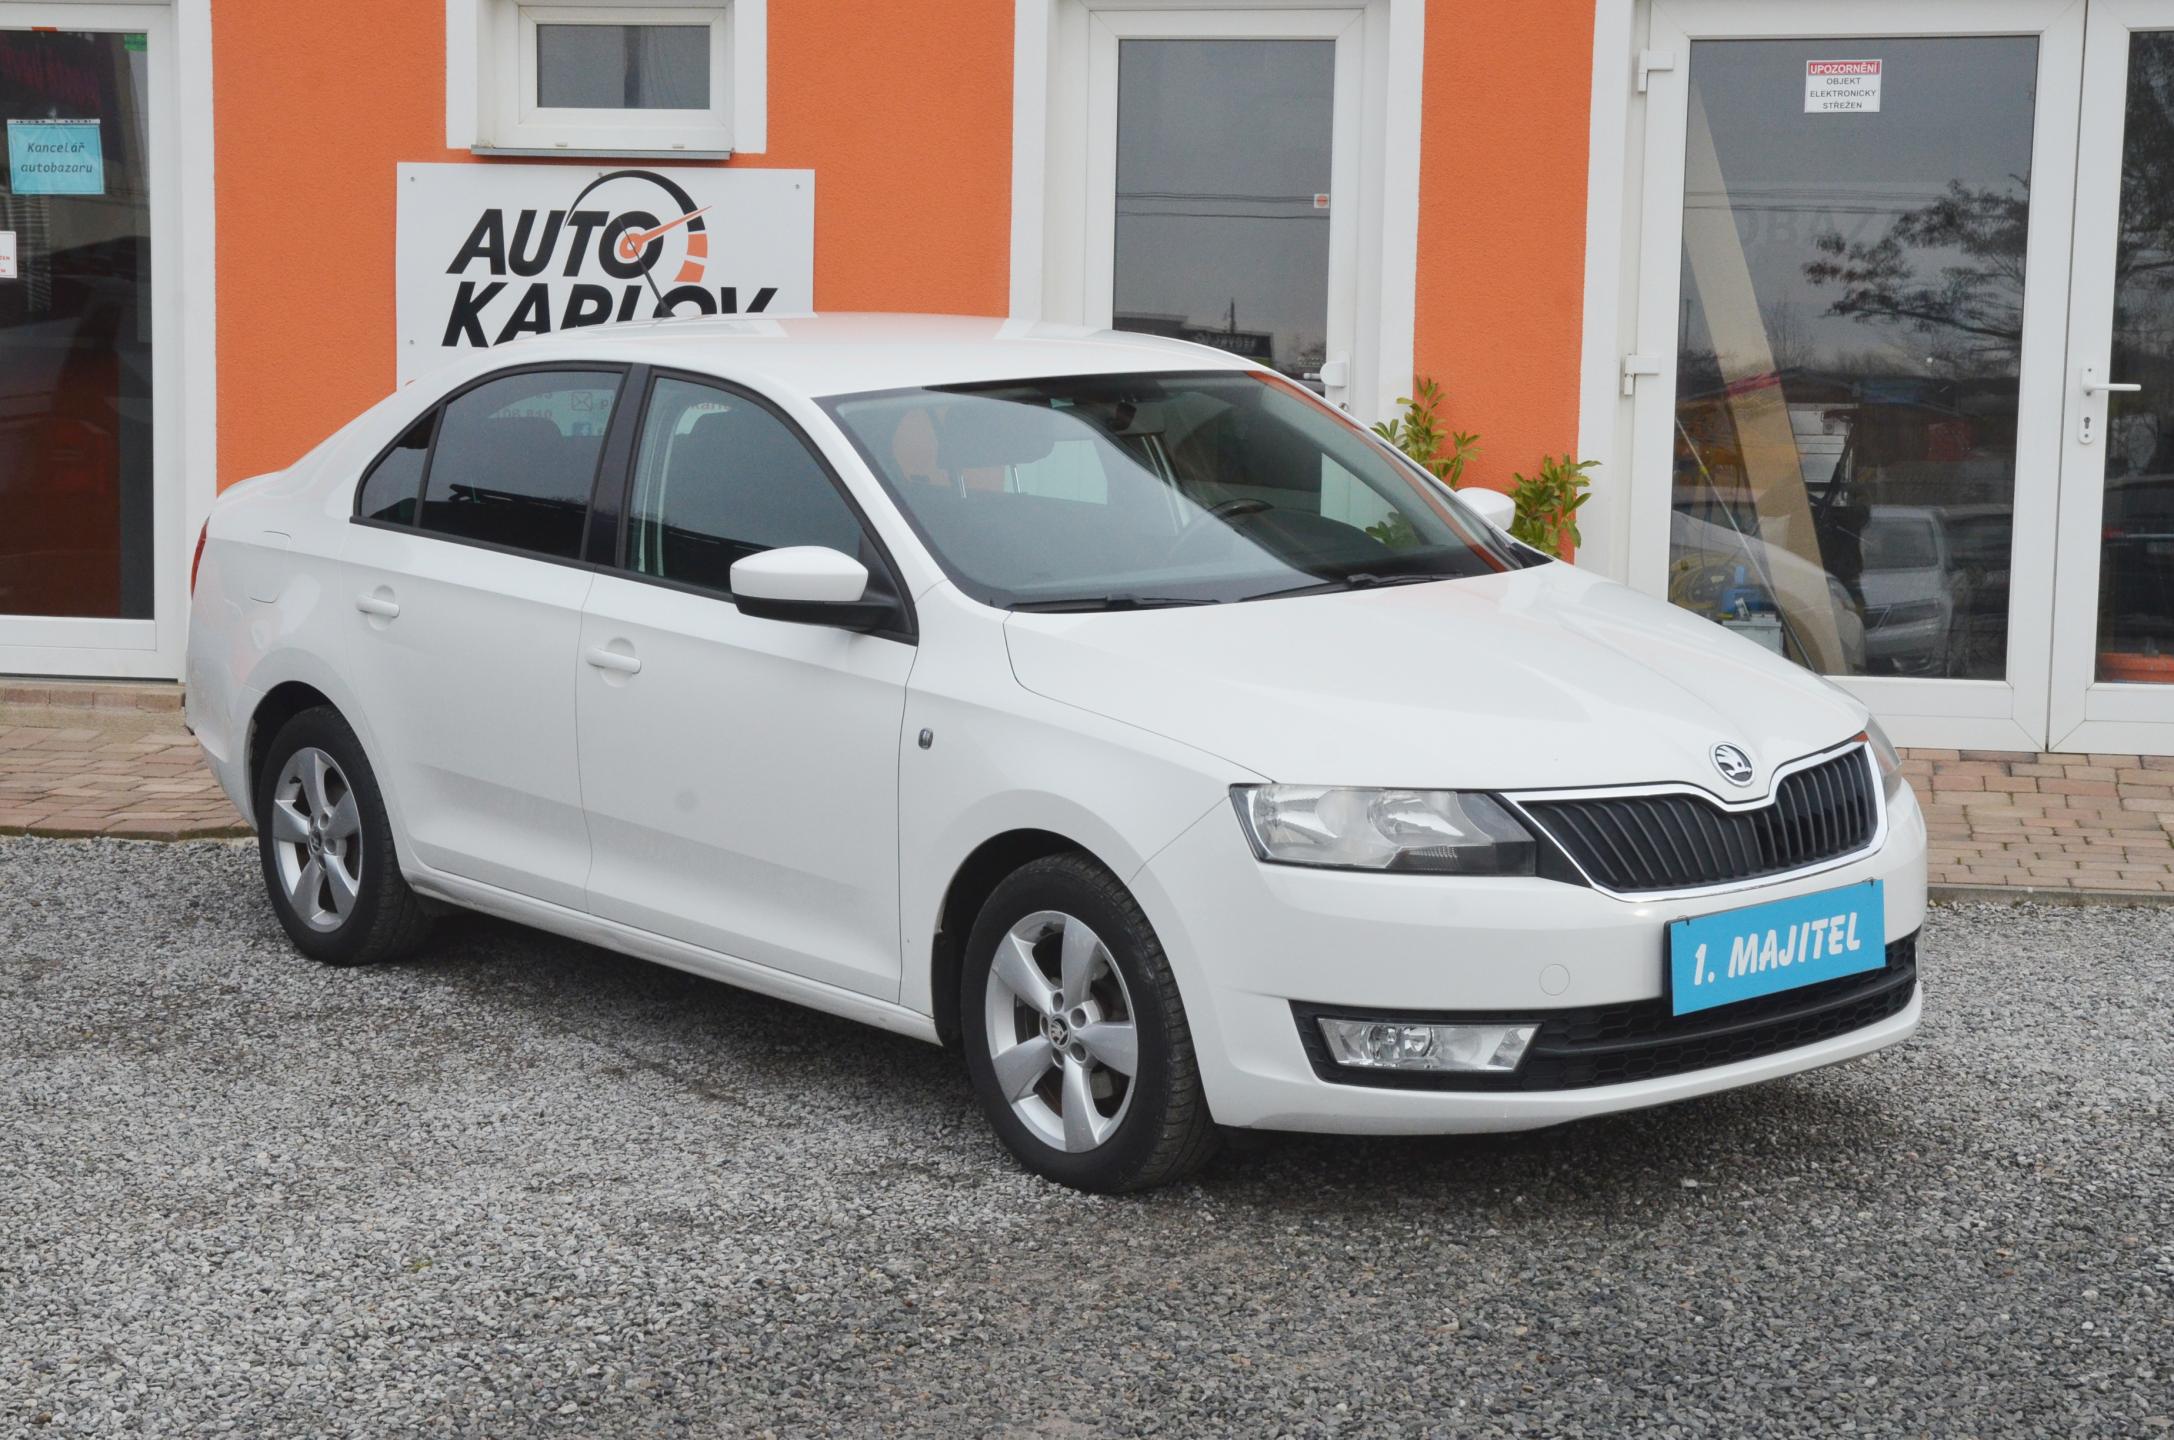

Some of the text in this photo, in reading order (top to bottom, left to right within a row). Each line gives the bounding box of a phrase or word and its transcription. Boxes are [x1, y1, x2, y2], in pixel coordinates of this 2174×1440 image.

[1810, 62, 1878, 74] UPOZORNĚNÍ
[1826, 77, 1861, 85] OBJEKT
[1809, 90, 1876, 98] ELEKTRONICKY
[27, 142, 85, 153] Kancelář
[20, 162, 93, 173] autobazaru
[446, 208, 665, 280] AUTO
[1693, 911, 1861, 986] 1. MAJITEL
